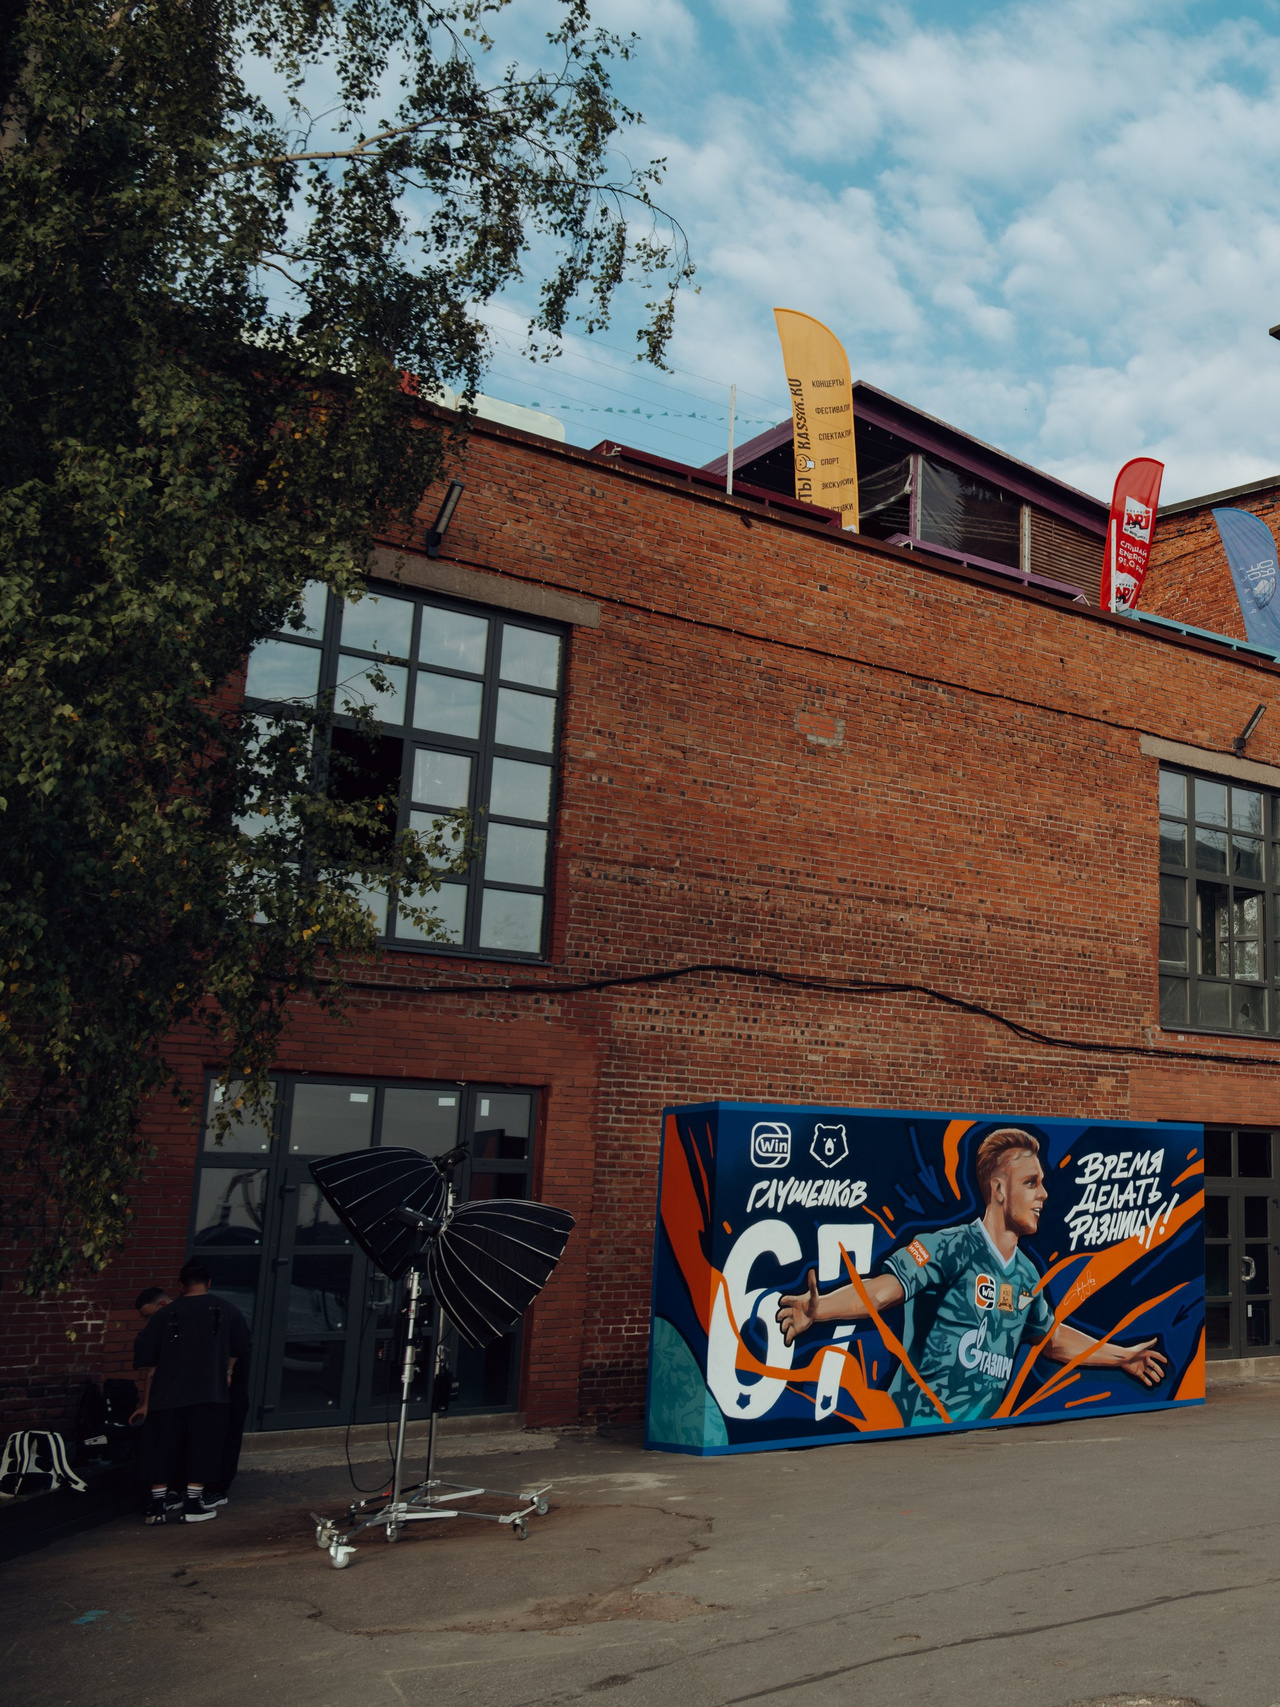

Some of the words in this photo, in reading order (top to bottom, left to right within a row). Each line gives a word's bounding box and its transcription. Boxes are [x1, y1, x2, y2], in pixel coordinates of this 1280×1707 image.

[812, 379, 845, 388] КОНЦЕРТЫ
[815, 404, 850, 415] ФЕСТИВАЛИ
[818, 429, 851, 441] СПЕКТАКЛИ
[820, 457, 839, 466] СПОРТ
[822, 478, 854, 490] ЭКСКУРСИИ
[828, 503, 854, 513] СТВКИ
[1119, 547, 1146, 565] ENERGY
[1120, 540, 1147, 558] СЛУШАЙ
[1118, 556, 1135, 568] 95.0
[1135, 564, 1144, 575] FM
[760, 1138, 787, 1153] Win
[1074, 1148, 1165, 1184] ВРЕМЯ
[746, 1176, 868, 1213] ГЛУШЕНКОВ
[1064, 1177, 1162, 1223] ДЕЛАТЬ
[1069, 1193, 1180, 1252] РАЗНИЦУ!
[908, 1245, 924, 1265] ИГРОК
[706, 1218, 874, 1422] 67
